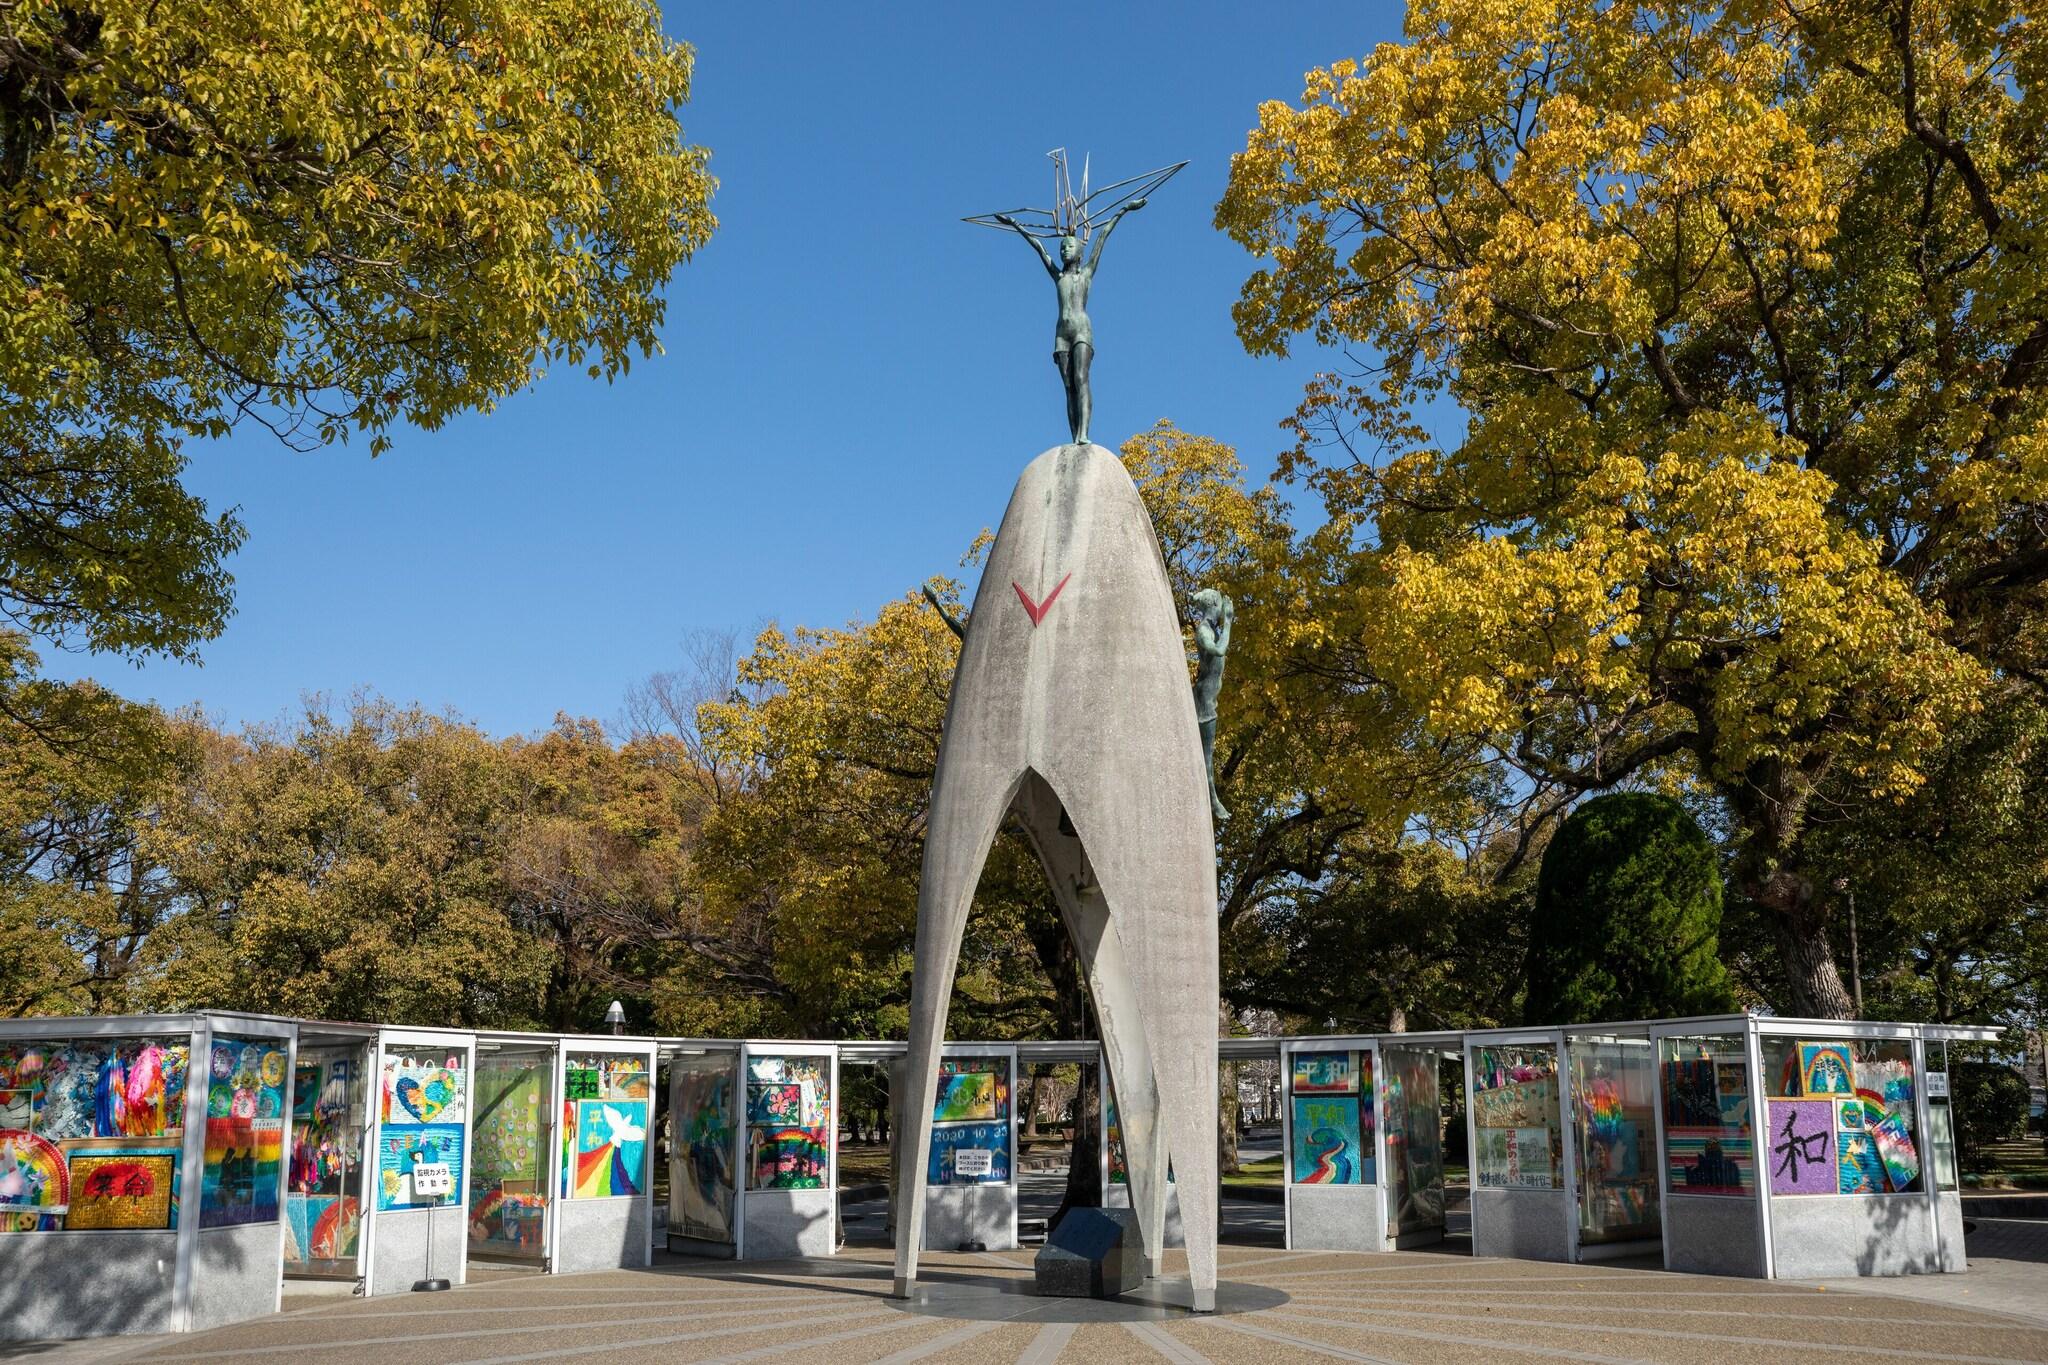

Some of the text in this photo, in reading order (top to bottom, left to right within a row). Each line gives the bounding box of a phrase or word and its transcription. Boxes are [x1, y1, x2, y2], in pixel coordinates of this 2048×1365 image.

[940, 1144, 1009, 1168] 未へ
[1774, 1110, 1829, 1184] 和
[416, 1168, 447, 1177] 監視カメラ
